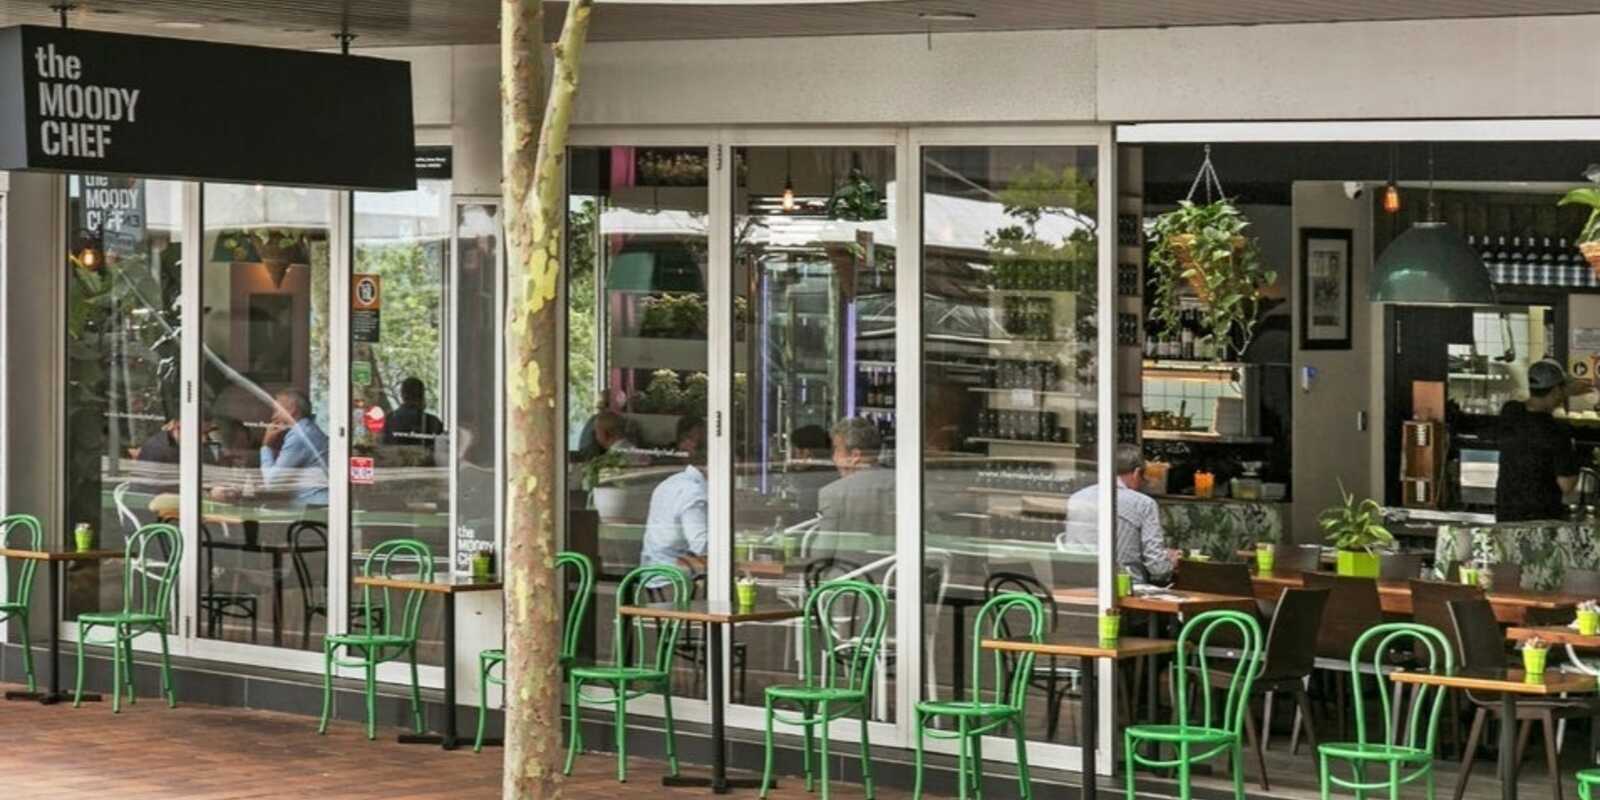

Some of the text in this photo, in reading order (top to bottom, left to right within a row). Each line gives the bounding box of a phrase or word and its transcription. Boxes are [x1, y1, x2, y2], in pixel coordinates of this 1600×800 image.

[34, 43, 82, 80] the
[38, 82, 141, 122] MOODY
[40, 120, 112, 159] CHEF
[86, 188, 139, 209] MOODY
